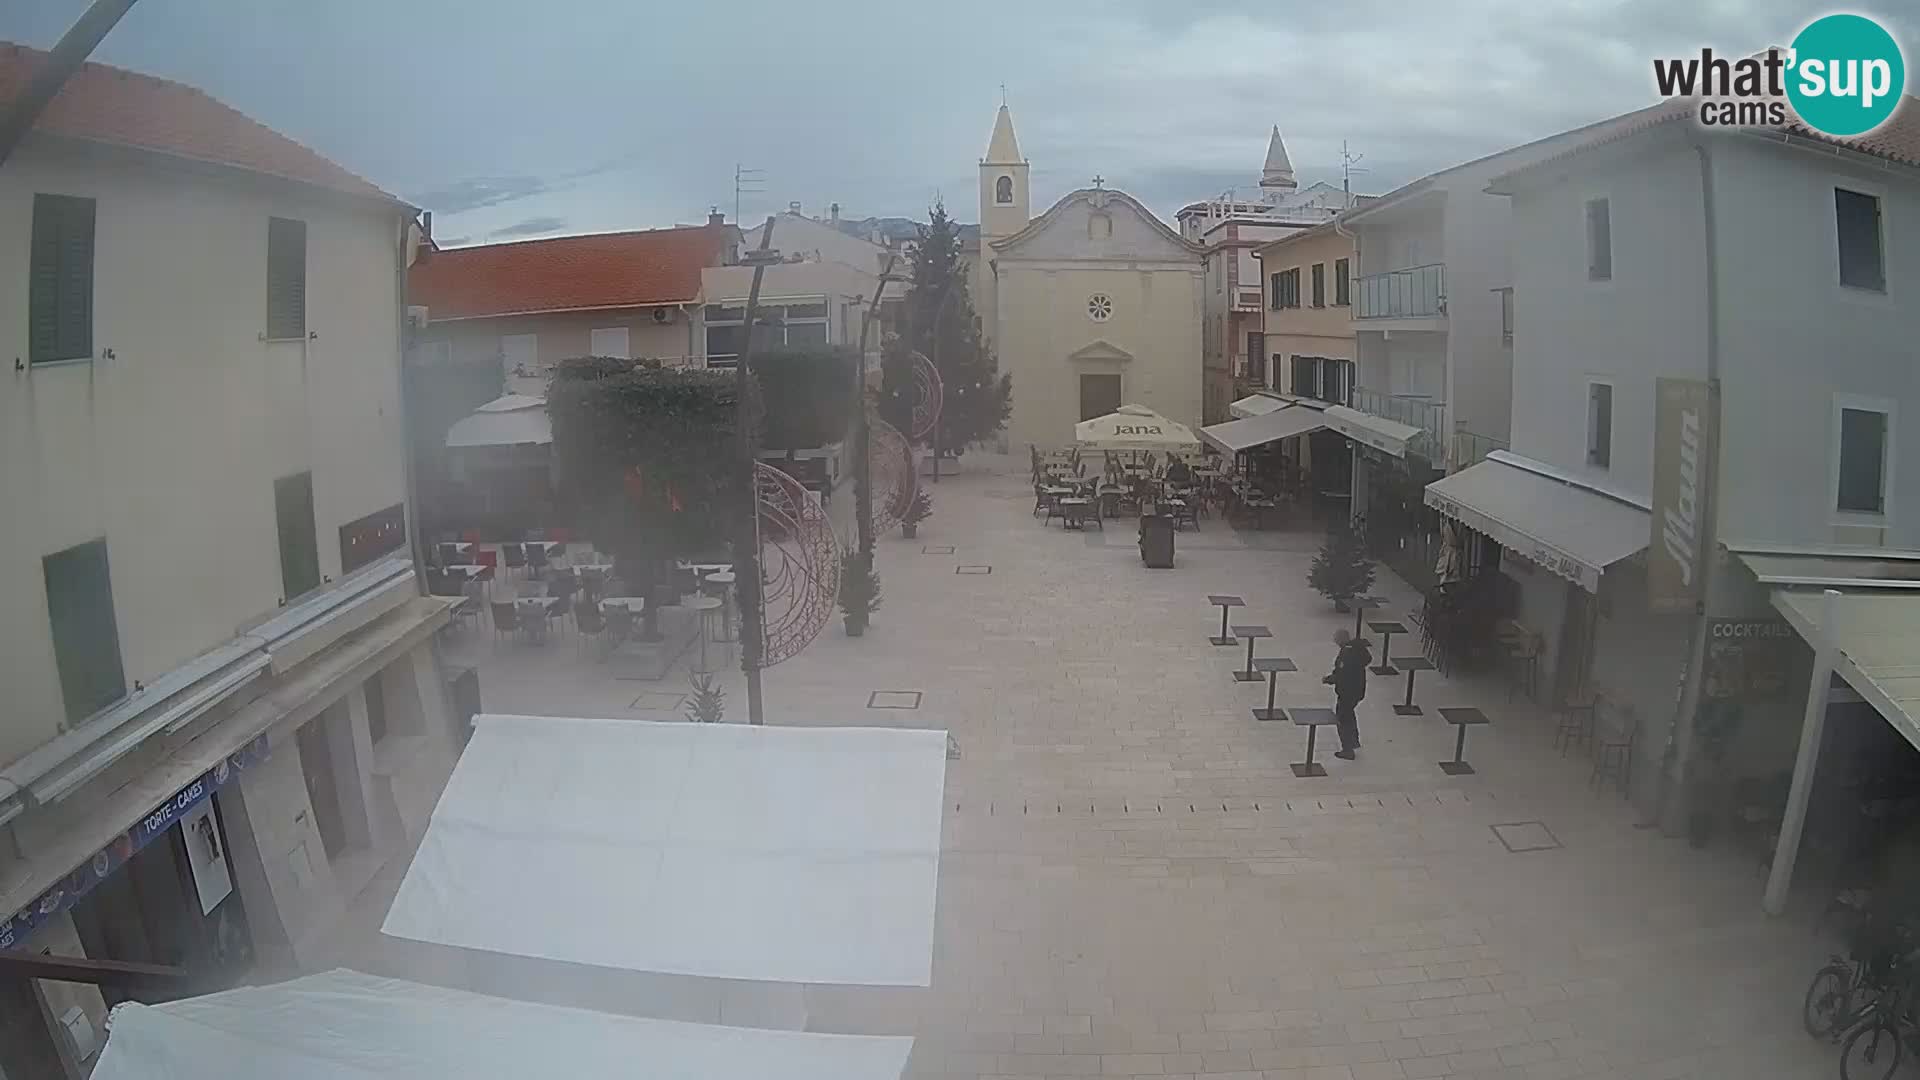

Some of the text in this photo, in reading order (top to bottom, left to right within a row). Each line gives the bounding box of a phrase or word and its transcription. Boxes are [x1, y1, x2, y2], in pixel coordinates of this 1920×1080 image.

[1713, 623, 1793, 637] COCKTAILS
[144, 807, 172, 834] TORTE
[178, 781, 203, 809] CAKES
